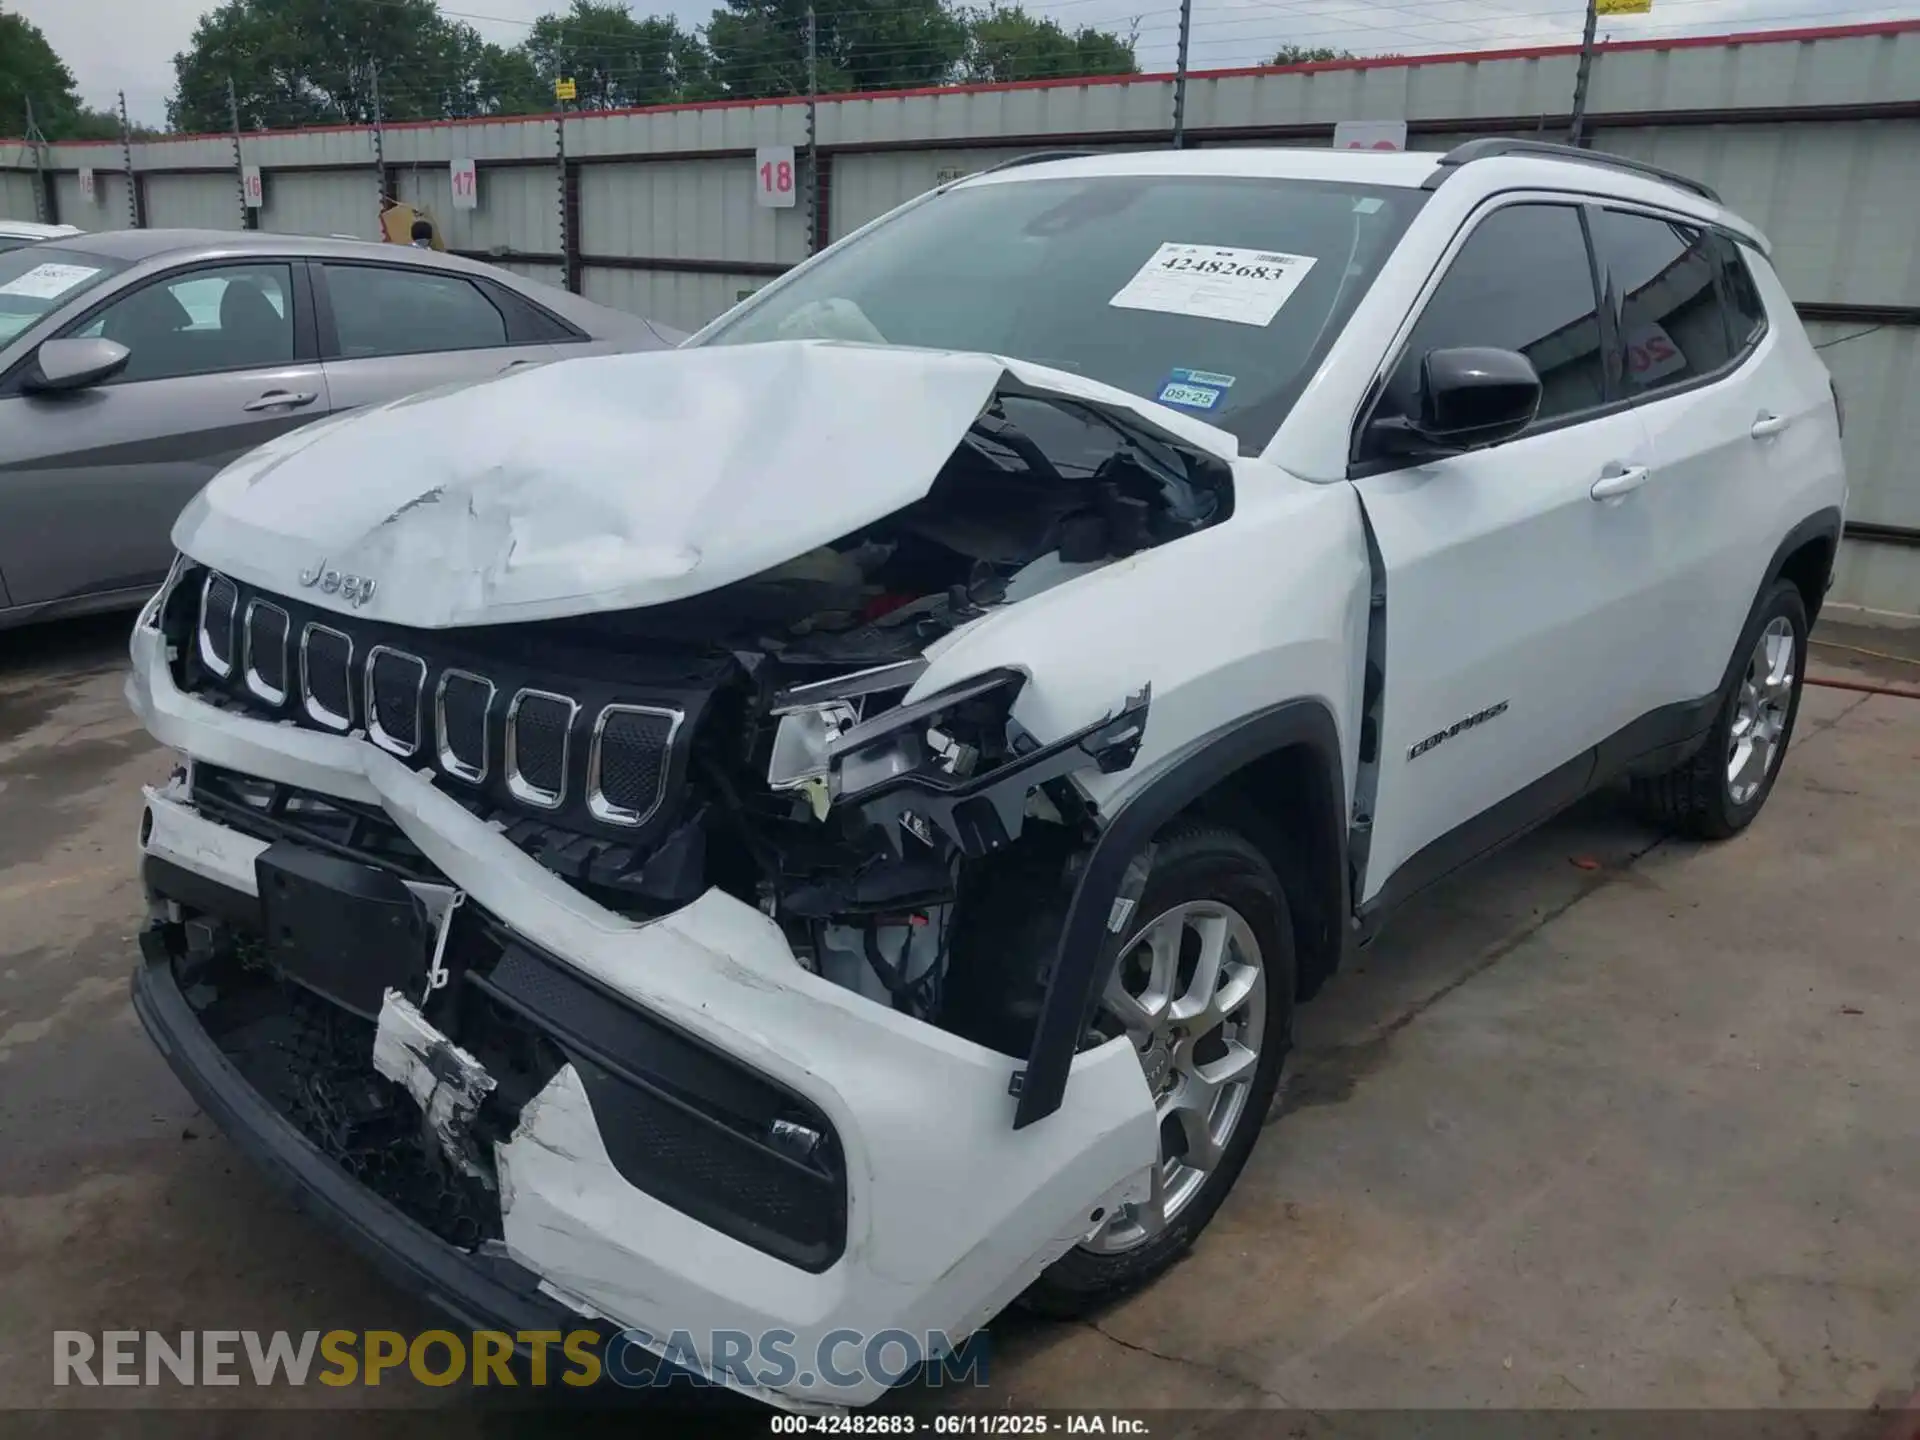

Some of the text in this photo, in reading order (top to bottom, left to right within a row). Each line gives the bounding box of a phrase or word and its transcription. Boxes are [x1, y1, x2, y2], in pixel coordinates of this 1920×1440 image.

[246, 175, 261, 197] 16
[453, 171, 474, 196] 17
[760, 160, 793, 193] 18
[1161, 256, 1284, 281] 42482683
[299, 556, 377, 609] Jeep
